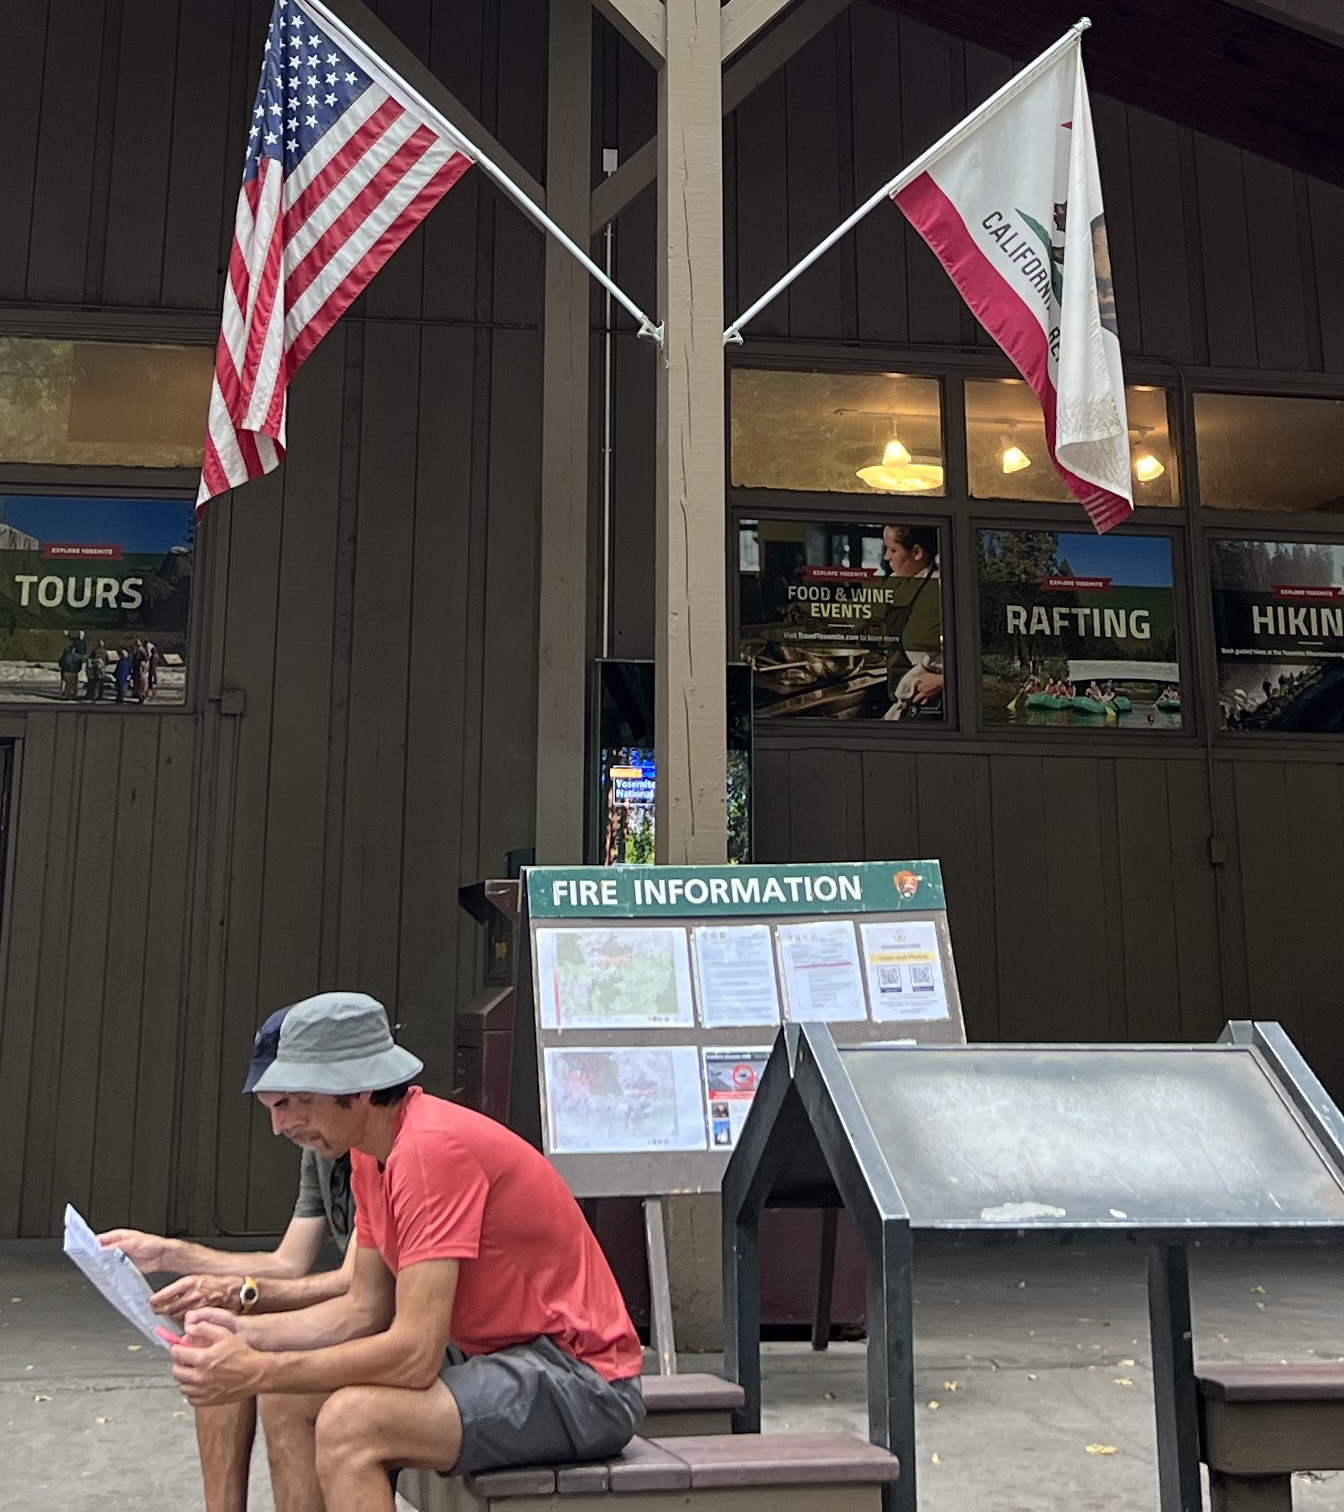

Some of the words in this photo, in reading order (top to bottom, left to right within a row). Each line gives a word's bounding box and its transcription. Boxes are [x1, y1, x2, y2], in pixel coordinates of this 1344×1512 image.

[981, 210, 1052, 311] CALIFORNI
[14, 575, 143, 609] TOURS
[787, 586, 831, 601] FOOD
[835, 587, 848, 602] &
[851, 588, 894, 604] WINE
[810, 602, 872, 619] EVENTS
[1006, 604, 1151, 639] RAFTING
[616, 779, 655, 789] Yosemite
[616, 789, 654, 798] National
[552, 879, 618, 906] FIRE
[634, 874, 862, 906] INFORMATION
